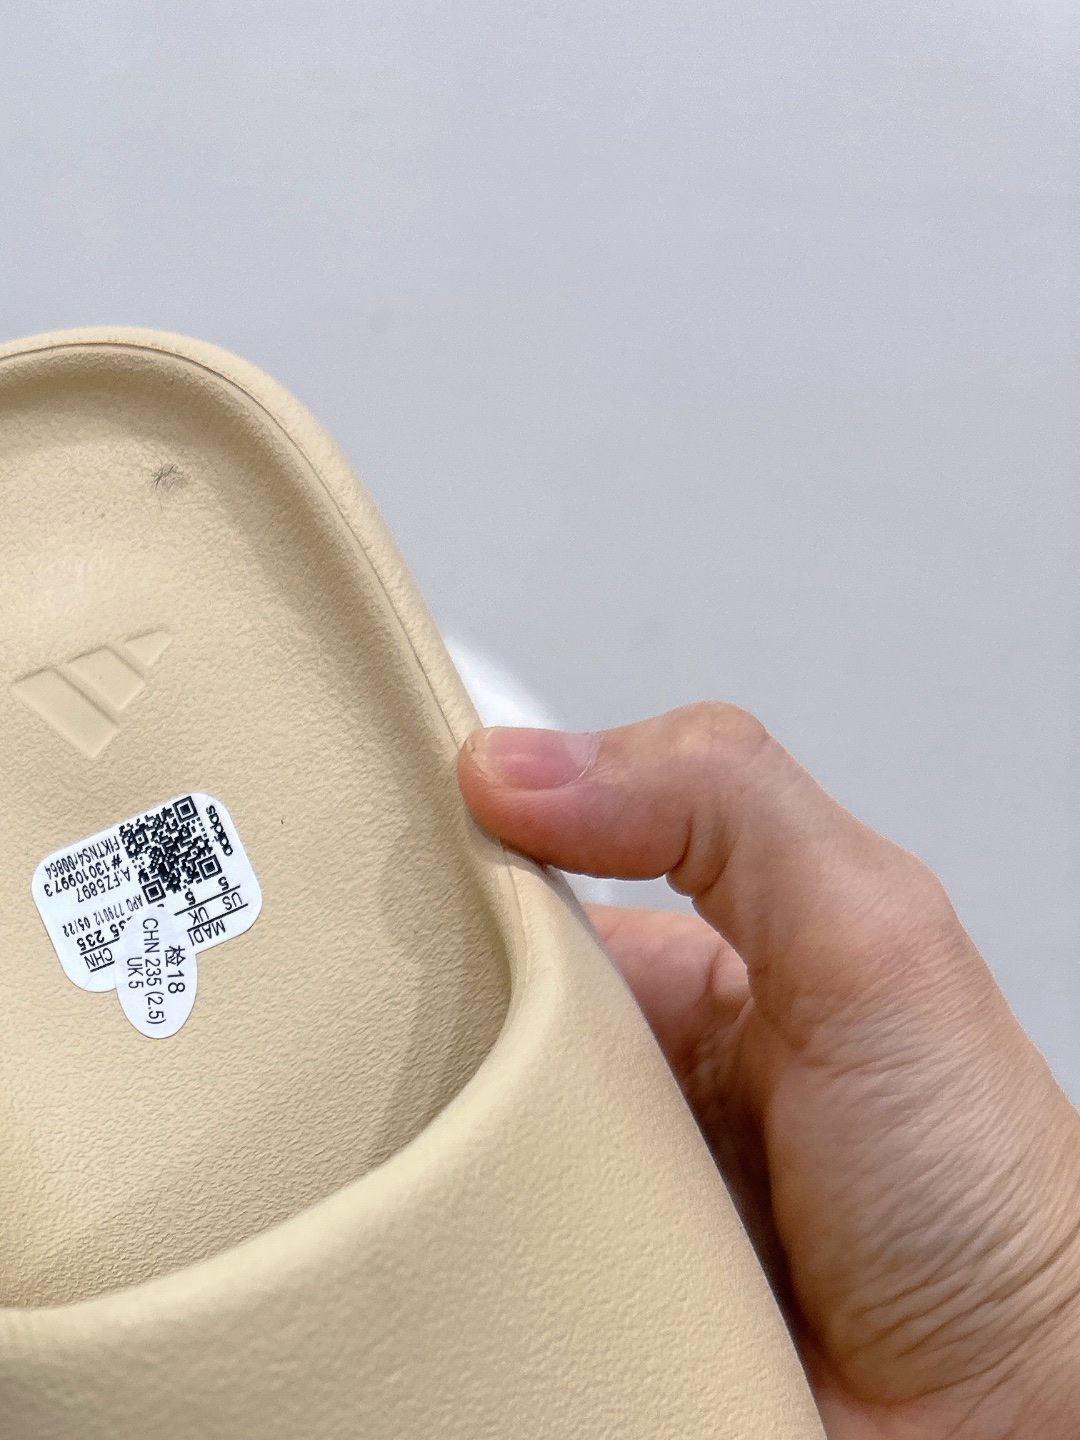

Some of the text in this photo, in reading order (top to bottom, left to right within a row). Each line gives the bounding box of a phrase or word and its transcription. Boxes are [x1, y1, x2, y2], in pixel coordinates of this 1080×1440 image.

[206, 805, 233, 856] adidas
[218, 876, 229, 891] 5
[185, 891, 195, 906] 5
[76, 930, 105, 951] 235
[84, 892, 243, 969] US UK CHN
[188, 920, 226, 946] MAD
[126, 957, 144, 989] UK 5
[142, 918, 166, 1024] CHN 235 (2.5)
